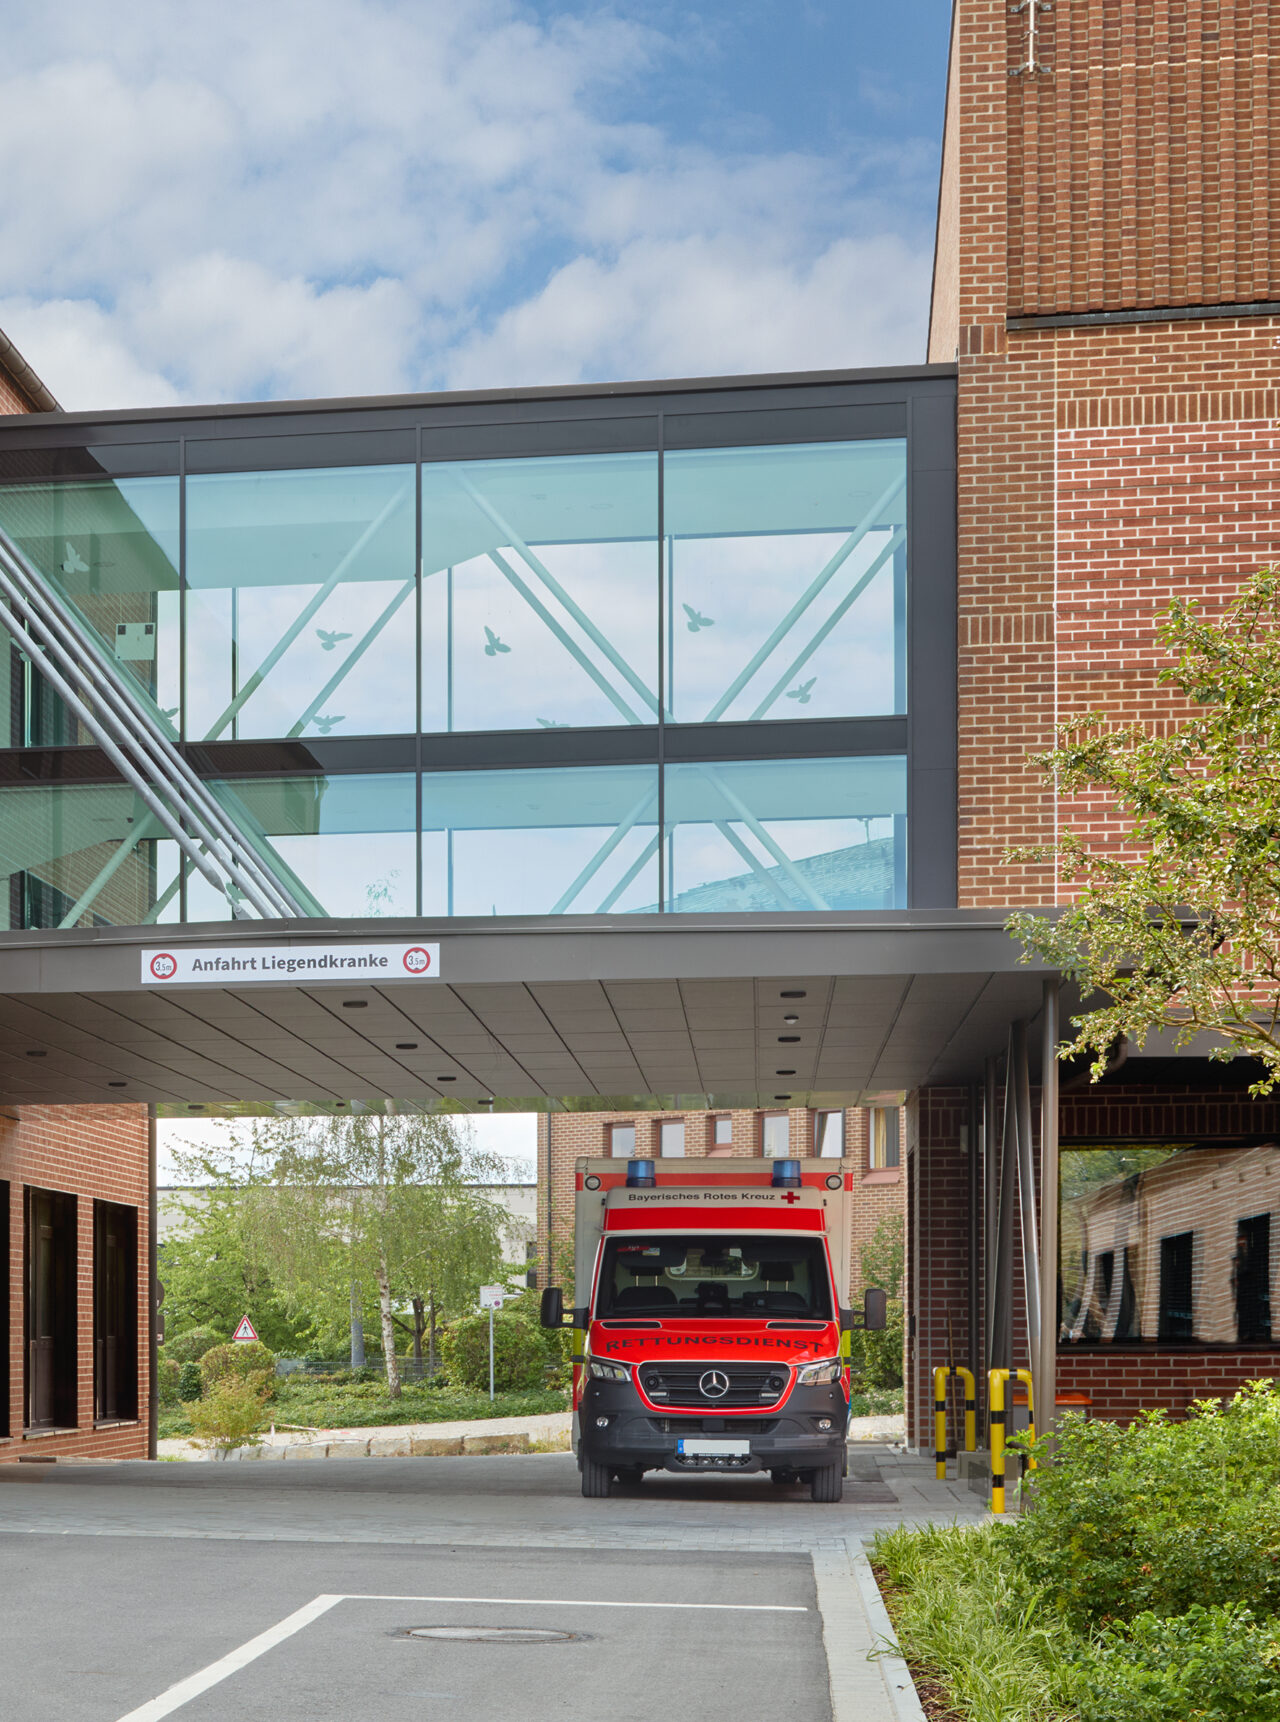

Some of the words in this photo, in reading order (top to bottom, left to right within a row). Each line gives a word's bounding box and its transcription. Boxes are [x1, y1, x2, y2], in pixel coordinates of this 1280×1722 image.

[192, 957, 257, 971] Anfahrt
[262, 954, 389, 973] Liegendkranke
[628, 1193, 700, 1202] Bayerisches
[703, 1192, 738, 1200] Rotes
[741, 1192, 776, 1200] Kreuz
[606, 1336, 824, 1353] RETTUNGSDIENST
